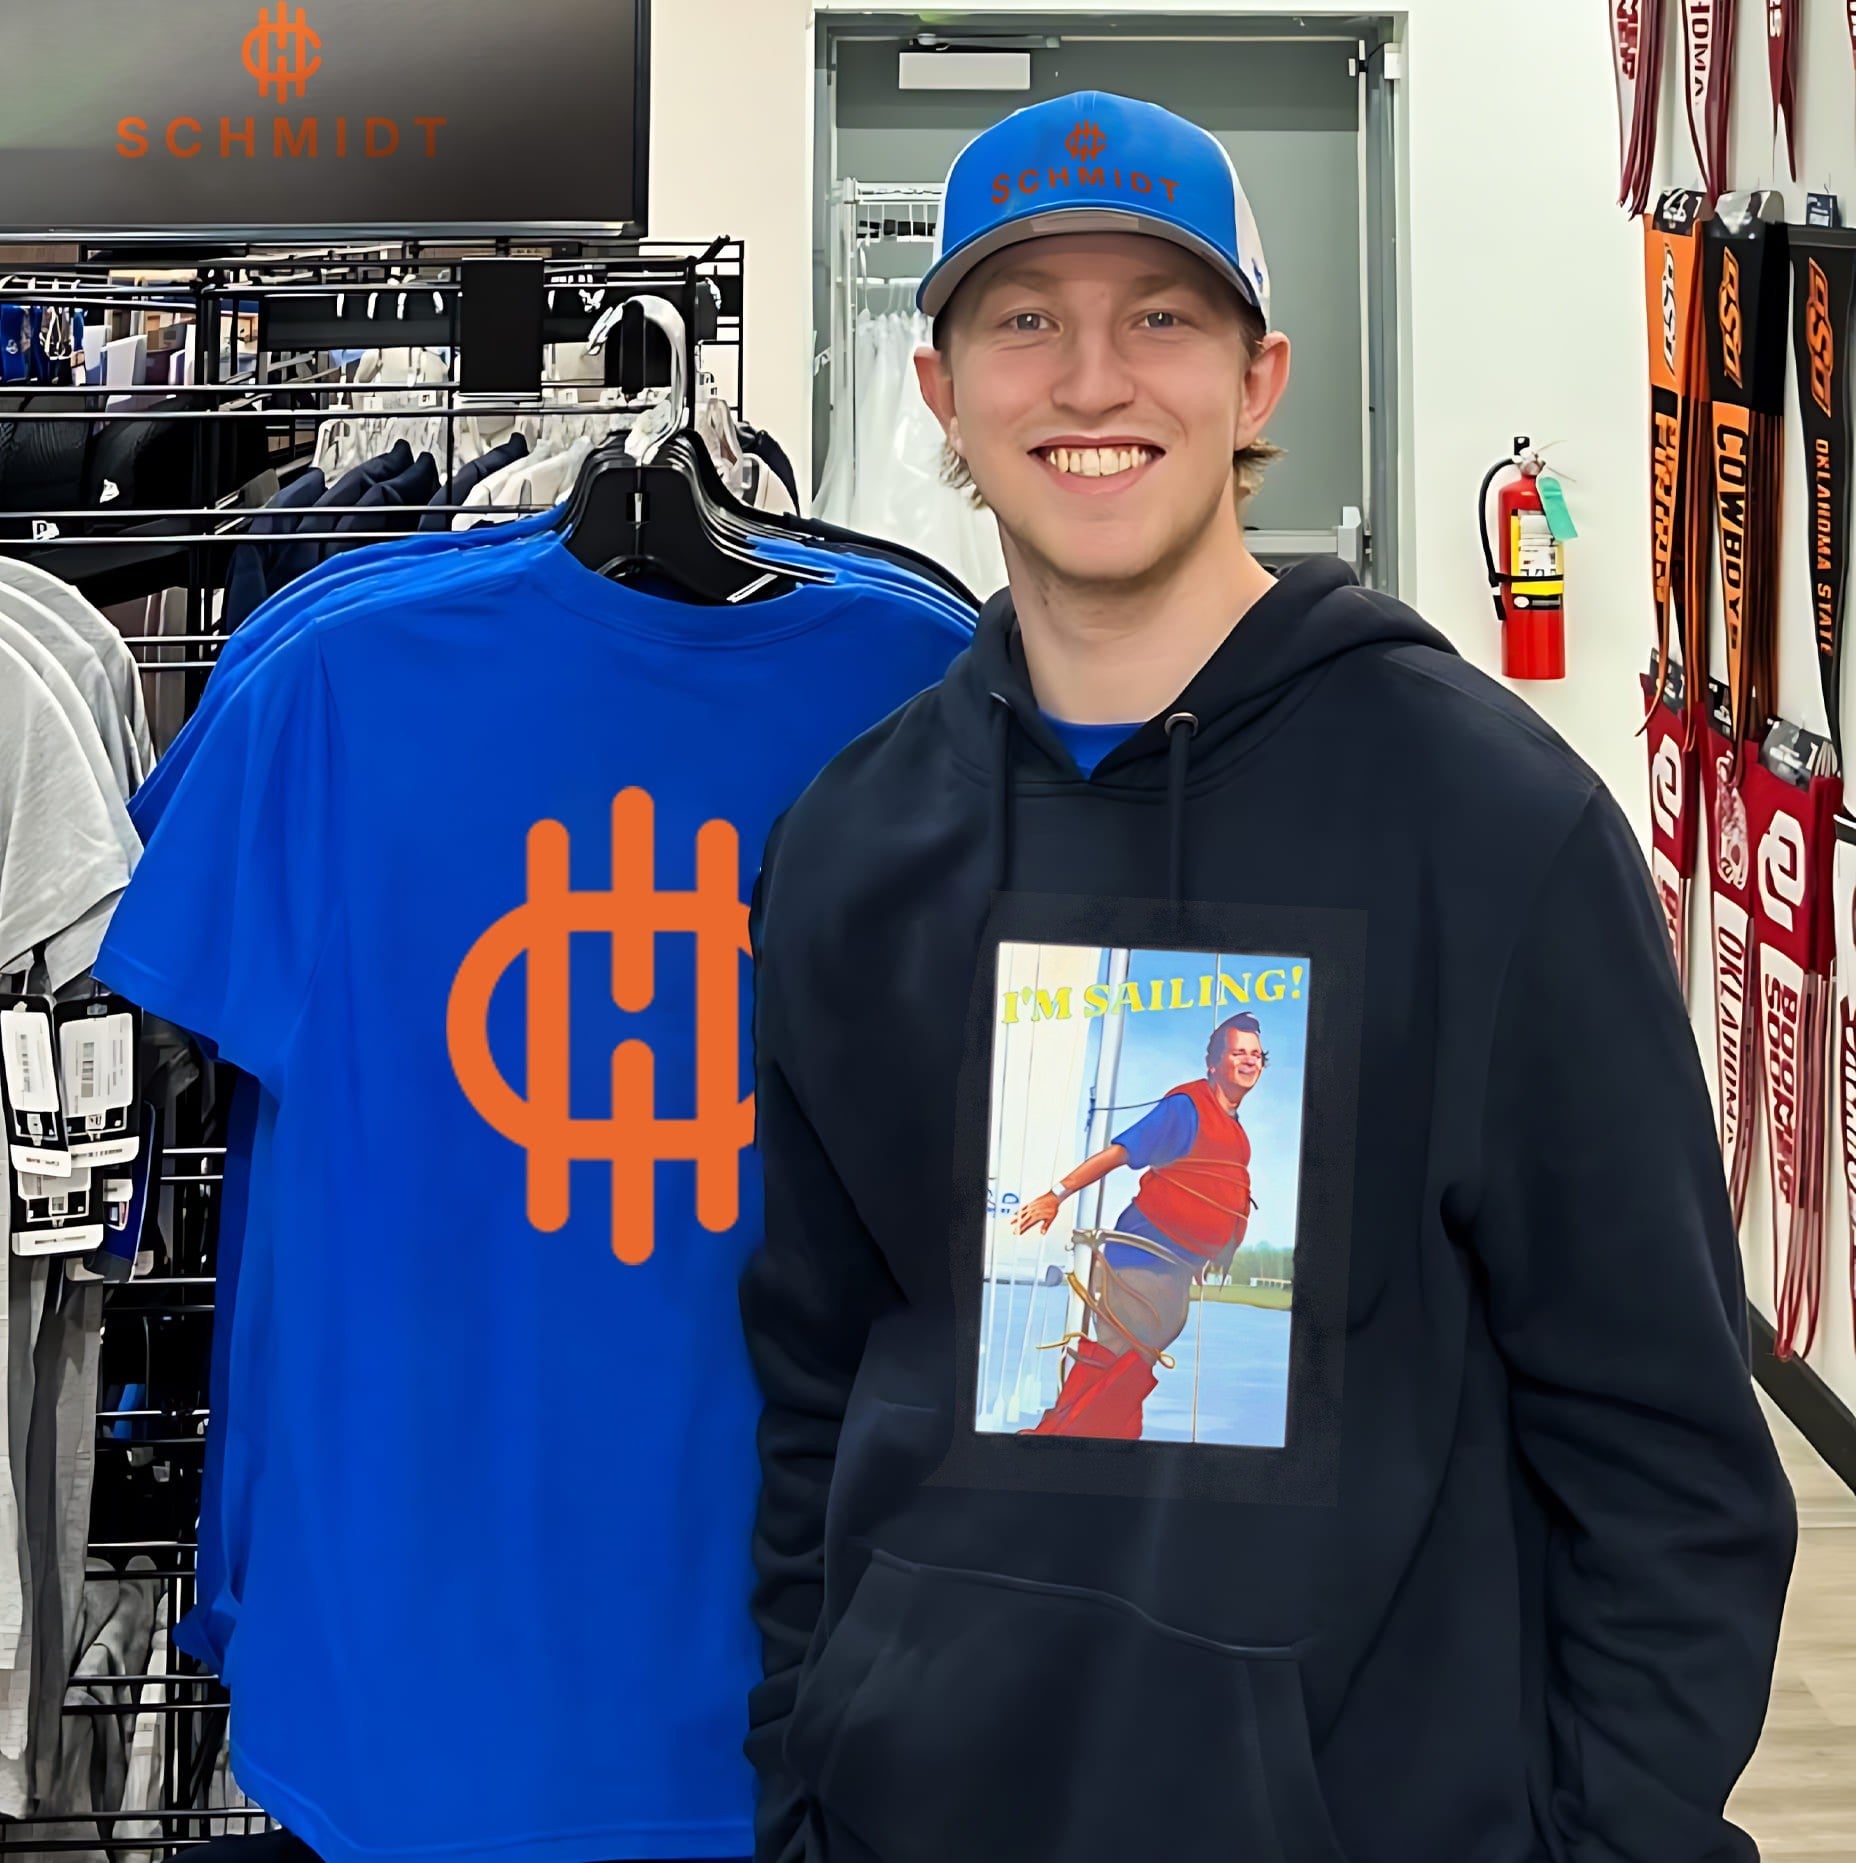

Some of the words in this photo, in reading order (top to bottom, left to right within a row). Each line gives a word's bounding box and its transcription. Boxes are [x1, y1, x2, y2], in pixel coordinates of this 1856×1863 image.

[116, 116, 448, 158] SCHMIDT
[991, 166, 1179, 205] SCHMIDT
[1815, 438, 1832, 570] OKLAHOMA
[1001, 986, 1073, 1024] I'M
[1084, 965, 1304, 1019] SAILING!
[1717, 926, 1745, 1144] OKLAHOMA
